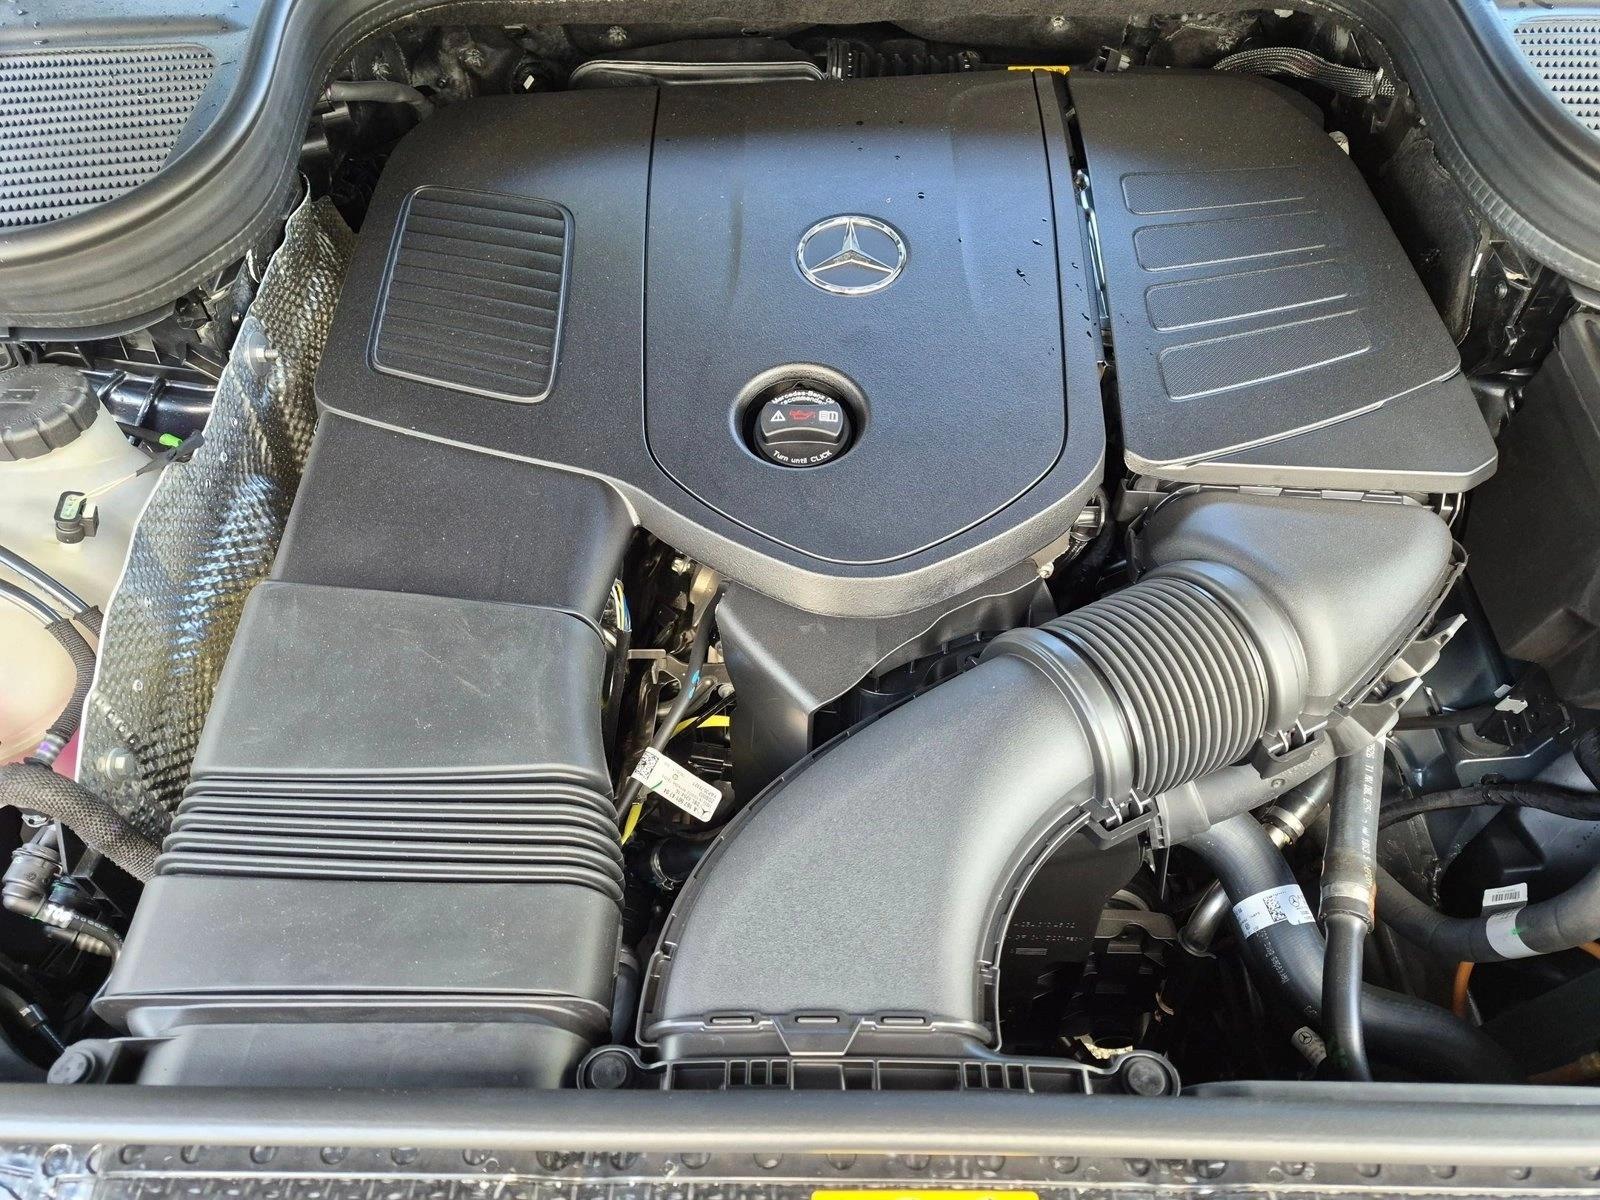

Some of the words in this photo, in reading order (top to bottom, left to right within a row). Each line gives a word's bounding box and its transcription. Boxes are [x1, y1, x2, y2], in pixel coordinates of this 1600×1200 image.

[771, 391, 825, 404] Mercedes-Benz
[773, 450, 789, 461] Turn
[810, 449, 833, 463] CLICK
